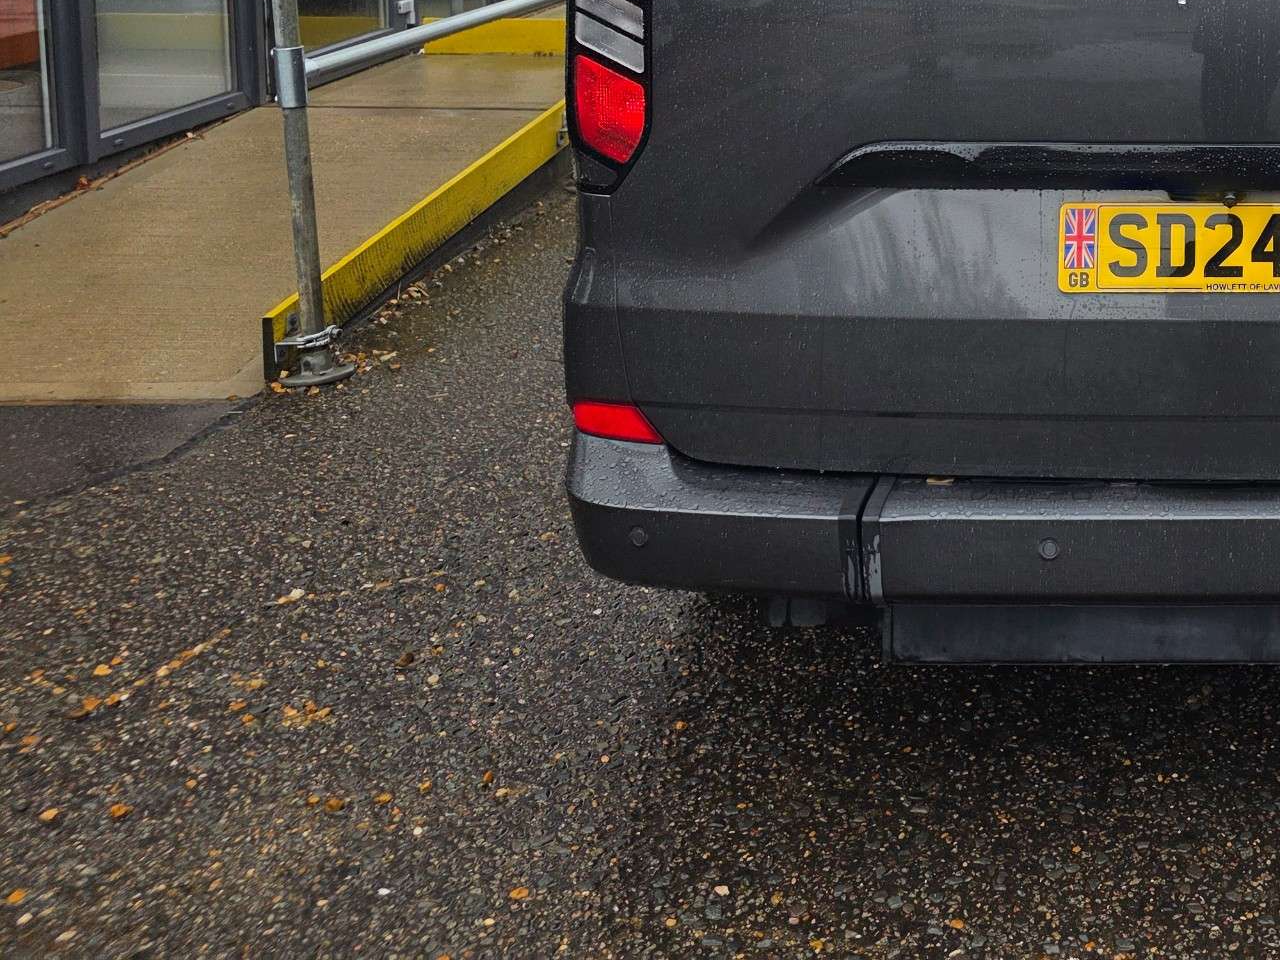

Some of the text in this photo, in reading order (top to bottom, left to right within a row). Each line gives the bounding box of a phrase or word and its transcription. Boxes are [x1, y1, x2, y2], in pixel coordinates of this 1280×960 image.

[1068, 273, 1090, 288] GB
[1206, 283, 1248, 291] HOWLETT
[1249, 283, 1263, 291] OF
